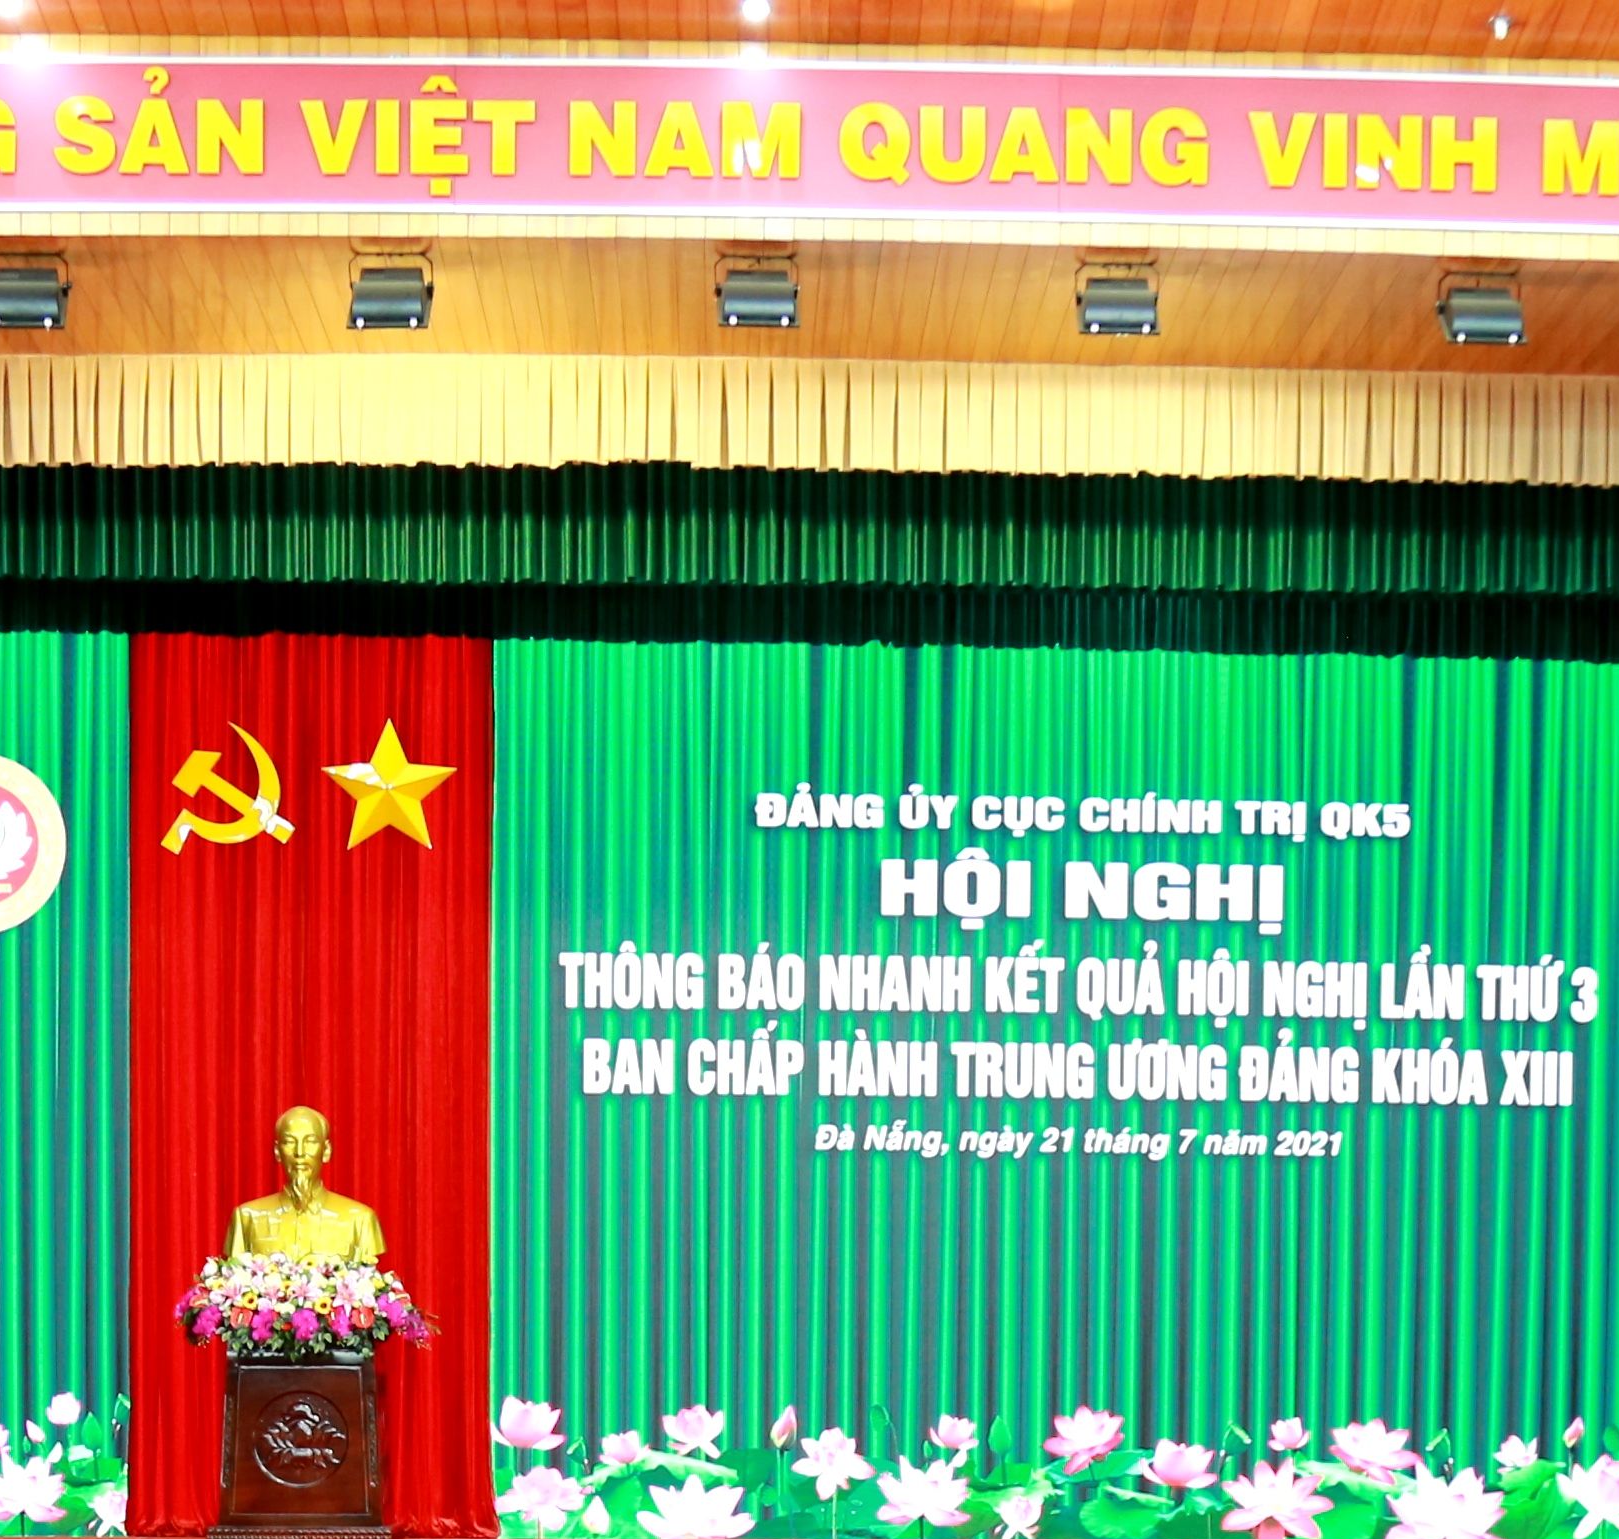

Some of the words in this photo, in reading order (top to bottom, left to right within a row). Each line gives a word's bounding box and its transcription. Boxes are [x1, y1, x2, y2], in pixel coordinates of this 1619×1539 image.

[55, 66, 264, 174] SẢN
[302, 75, 535, 195] VIỆT
[570, 101, 801, 178] NAM
[840, 103, 1208, 190] QUANG
[1250, 112, 1497, 191] VINH
[755, 783, 883, 828] ĐẢNG
[900, 784, 958, 829] ỦY
[973, 796, 1064, 837] CỤC
[1080, 792, 1222, 833] CHÍNH
[1235, 801, 1306, 842] TRỊ
[1321, 802, 1410, 839] QK5
[881, 848, 1031, 929] HỘI
[1065, 862, 1283, 934] NGHỊ
[559, 941, 704, 1009] THÔNG
[718, 942, 805, 1010] BÁO
[820, 955, 971, 1012] NHANH
[986, 940, 1065, 1013] KẾT
[1077, 940, 1165, 1020] QUẢ
[1178, 949, 1249, 1028] HỘI
[1263, 961, 1367, 1030] NGHỊ
[1381, 945, 1464, 1019] LẦN
[1477, 955, 1564, 1021] THỨ
[1571, 967, 1598, 1022] 3
[584, 1038, 674, 1094] BAN
[688, 1020, 804, 1095] CHẤP
[819, 1029, 937, 1096] HÀNH
[951, 1042, 1094, 1099] TRUNG
[1108, 1038, 1227, 1101] ƯƠNG
[1239, 1028, 1359, 1103] ĐẢNG
[1372, 1038, 1488, 1104] KHÓA
[1500, 1051, 1573, 1106] XIII
[815, 1124, 855, 1150] Đà
[864, 1120, 949, 1157] Nẵng,
[959, 1125, 1033, 1158] ngày
[1040, 1127, 1074, 1152] 21
[1084, 1128, 1170, 1160] tháng
[1179, 1129, 1197, 1154] 7
[1204, 1130, 1267, 1155] năm
[1274, 1131, 1342, 1156] 2021
